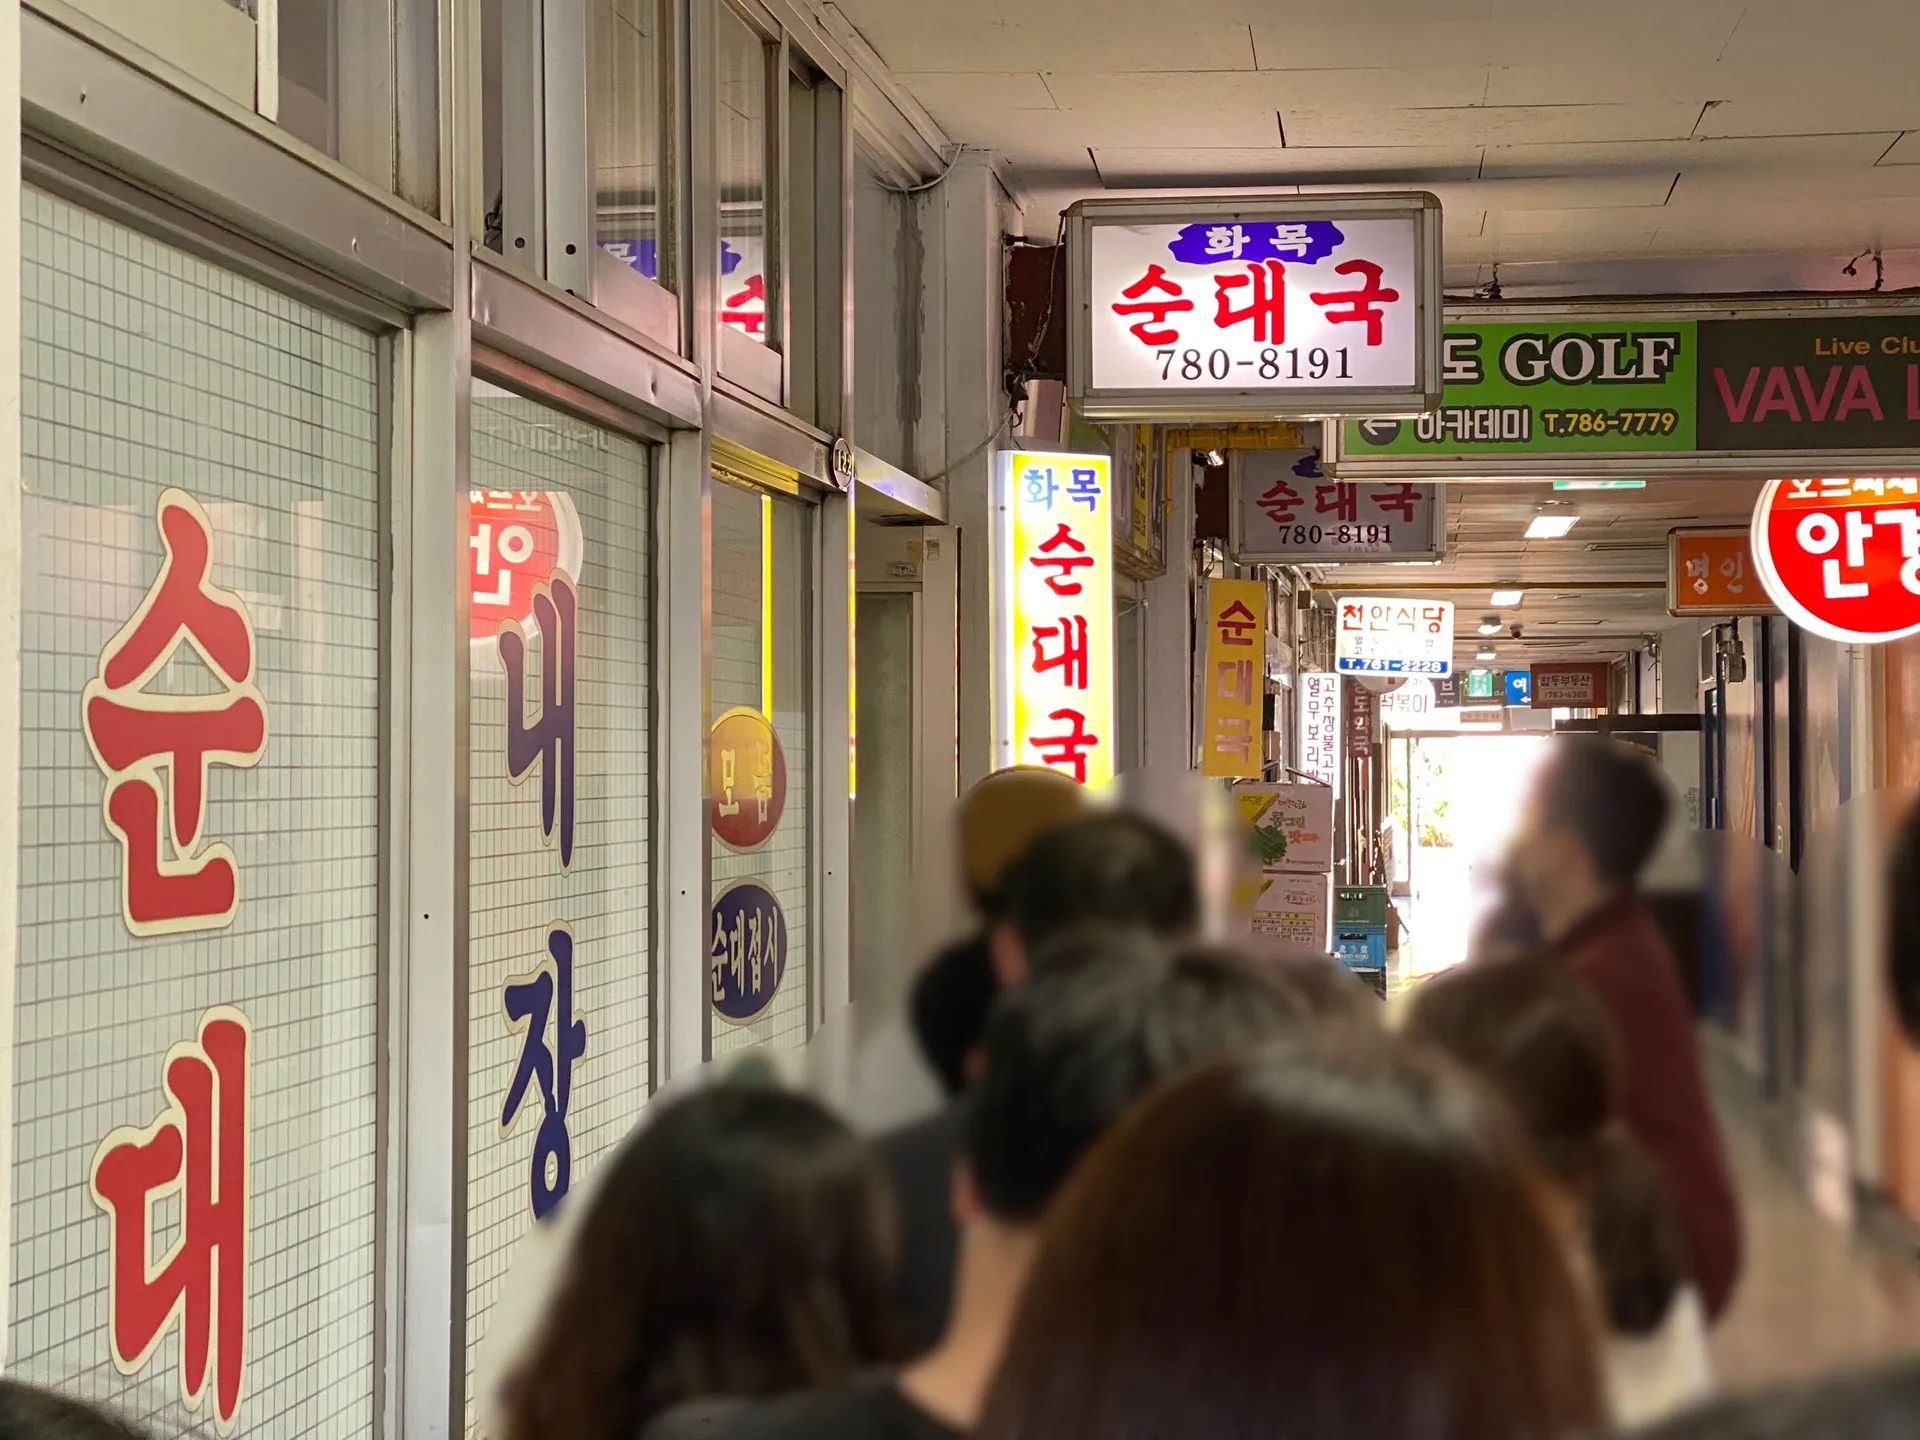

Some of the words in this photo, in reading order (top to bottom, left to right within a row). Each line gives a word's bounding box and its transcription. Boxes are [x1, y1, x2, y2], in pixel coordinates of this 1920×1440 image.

[1111, 259, 1400, 346] 순대국
[1156, 347, 1354, 380] 780-8191
[1504, 337, 1676, 381] GOLF
[1815, 337, 1871, 356] Live
[1713, 365, 1884, 423] VAVA
[1417, 408, 1529, 440] 아카데미
[1544, 412, 1676, 435] T.786-7779
[1256, 480, 1423, 523] 순대국
[1279, 525, 1393, 545] 780-8191
[1343, 605, 1445, 633] 천안식당
[1029, 523, 1099, 785] 순대국
[1346, 658, 1441, 672] T.761-2228
[1215, 600, 1257, 764] 순대국
[500, 570, 589, 1220] 내장
[84, 496, 270, 1428] 순대
[711, 907, 778, 1002] 순대접시
